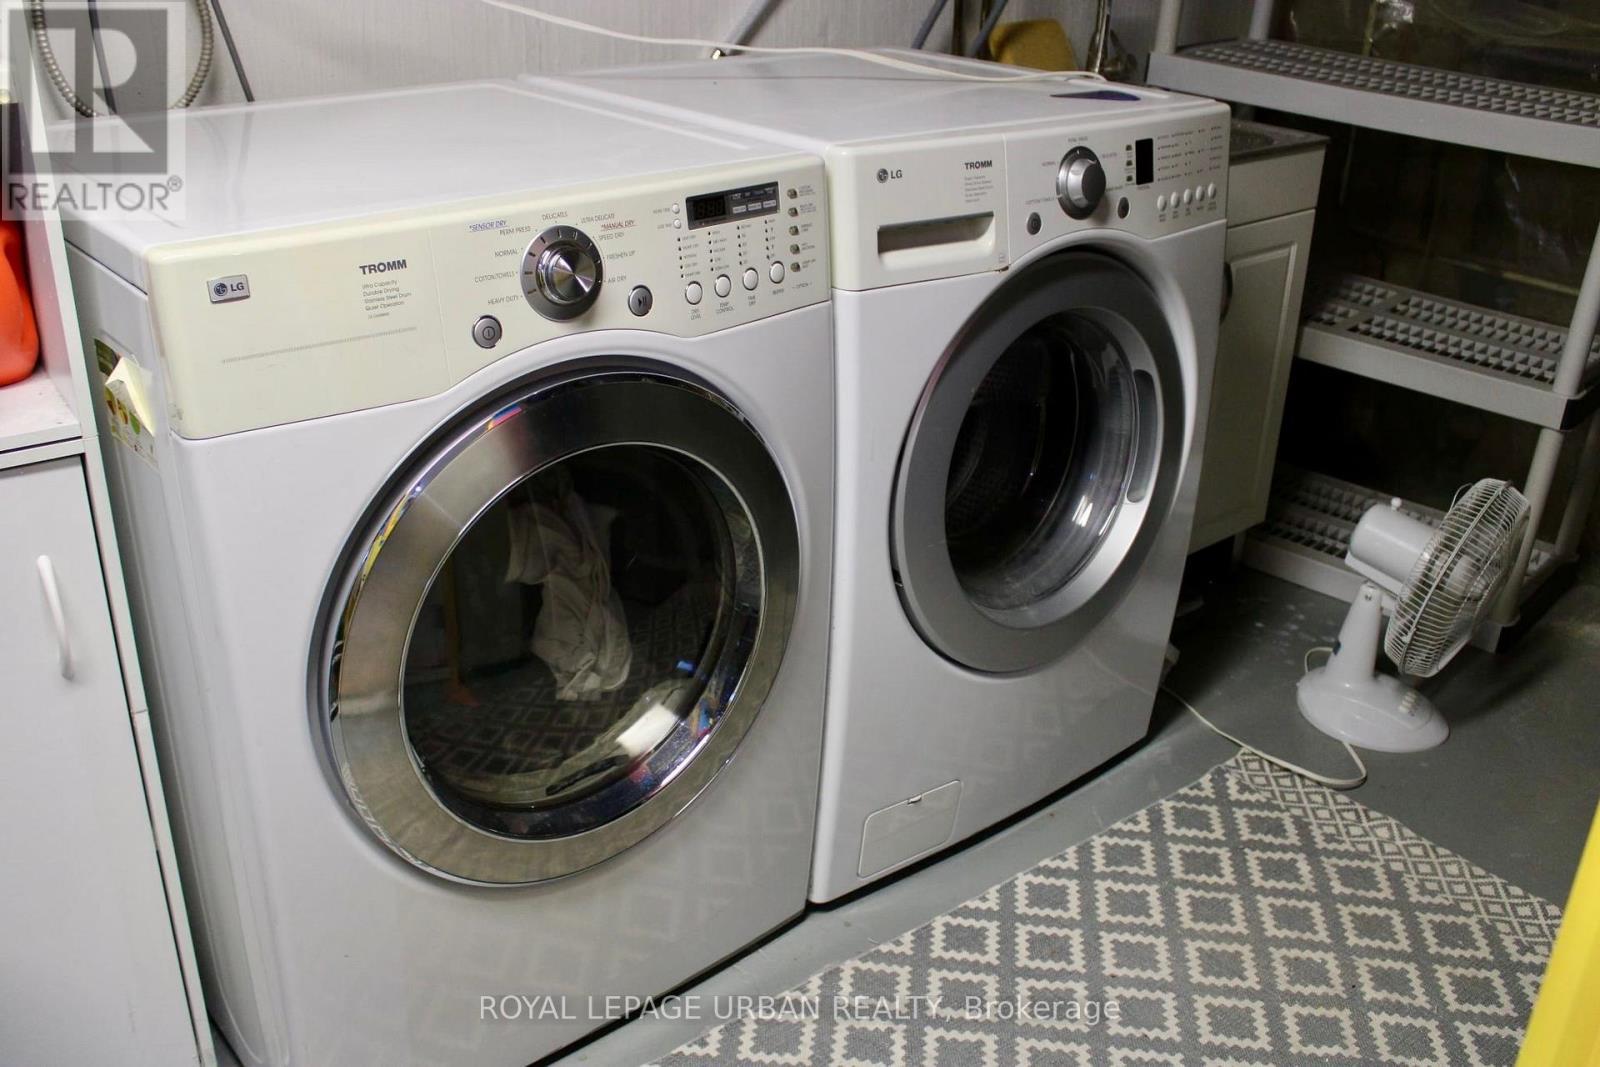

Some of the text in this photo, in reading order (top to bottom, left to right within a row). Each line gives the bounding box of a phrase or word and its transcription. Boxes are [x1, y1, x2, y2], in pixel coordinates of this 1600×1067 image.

[964, 160, 993, 170] TROMM
[890, 169, 903, 179] LG
[494, 248, 518, 258] NORMAL
[358, 258, 408, 275] TROMM
[230, 282, 245, 293] LG
[487, 294, 519, 305] HEAVY DUTY
